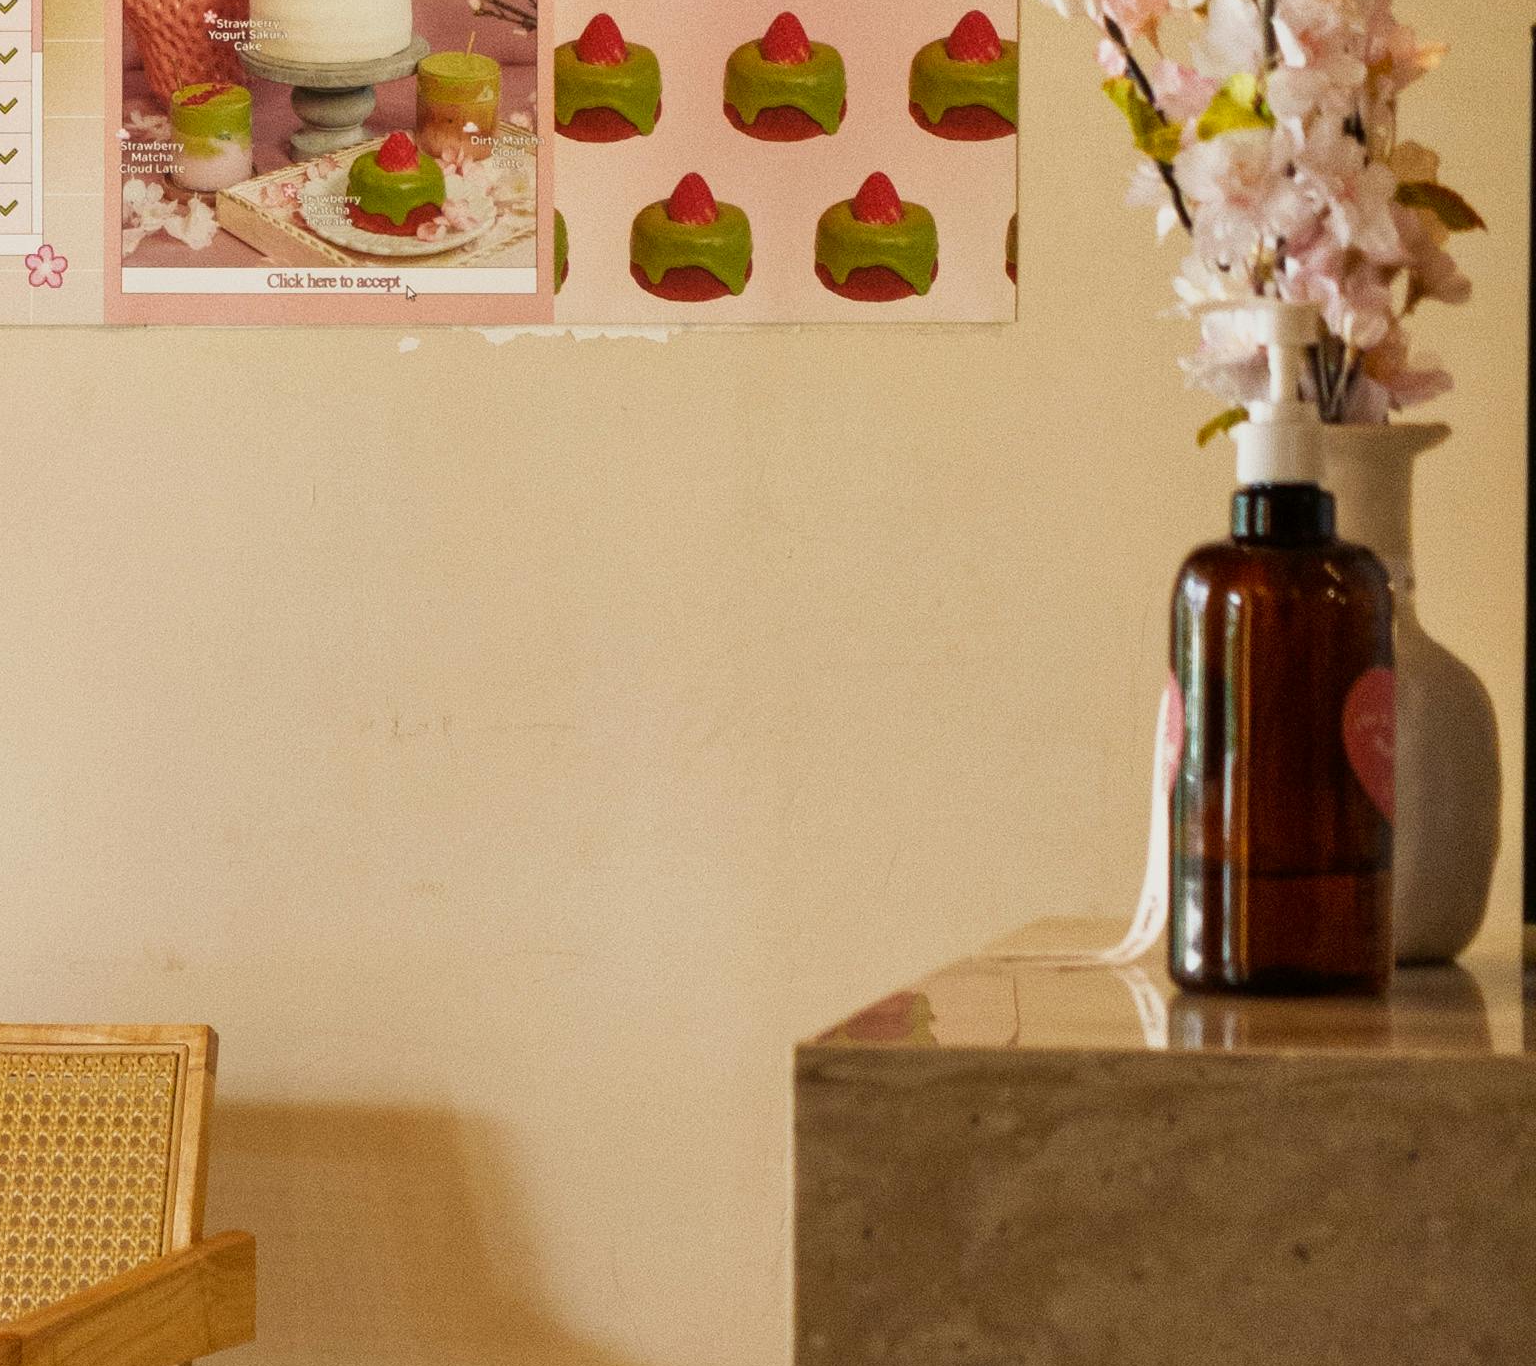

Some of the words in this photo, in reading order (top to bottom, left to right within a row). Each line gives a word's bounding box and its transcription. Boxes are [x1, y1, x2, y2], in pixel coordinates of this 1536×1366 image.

[216, 19, 280, 31] Strawberry
[208, 30, 246, 42] Yogurt
[249, 29, 288, 39] Sakura
[234, 42, 262, 51] Cake
[120, 141, 184, 153] Strawberry
[471, 136, 501, 147] Dirty
[504, 136, 545, 146] Matcha
[131, 152, 173, 162] Matcha
[491, 147, 525, 157] Cloud
[119, 164, 153, 174] Cloud
[155, 164, 185, 174] Latte
[296, 194, 361, 207] Strawberry
[308, 205, 350, 216] Matcha
[267, 273, 303, 288] Click
[307, 273, 337, 288] here
[340, 274, 353, 288] to
[357, 273, 400, 292] accept
